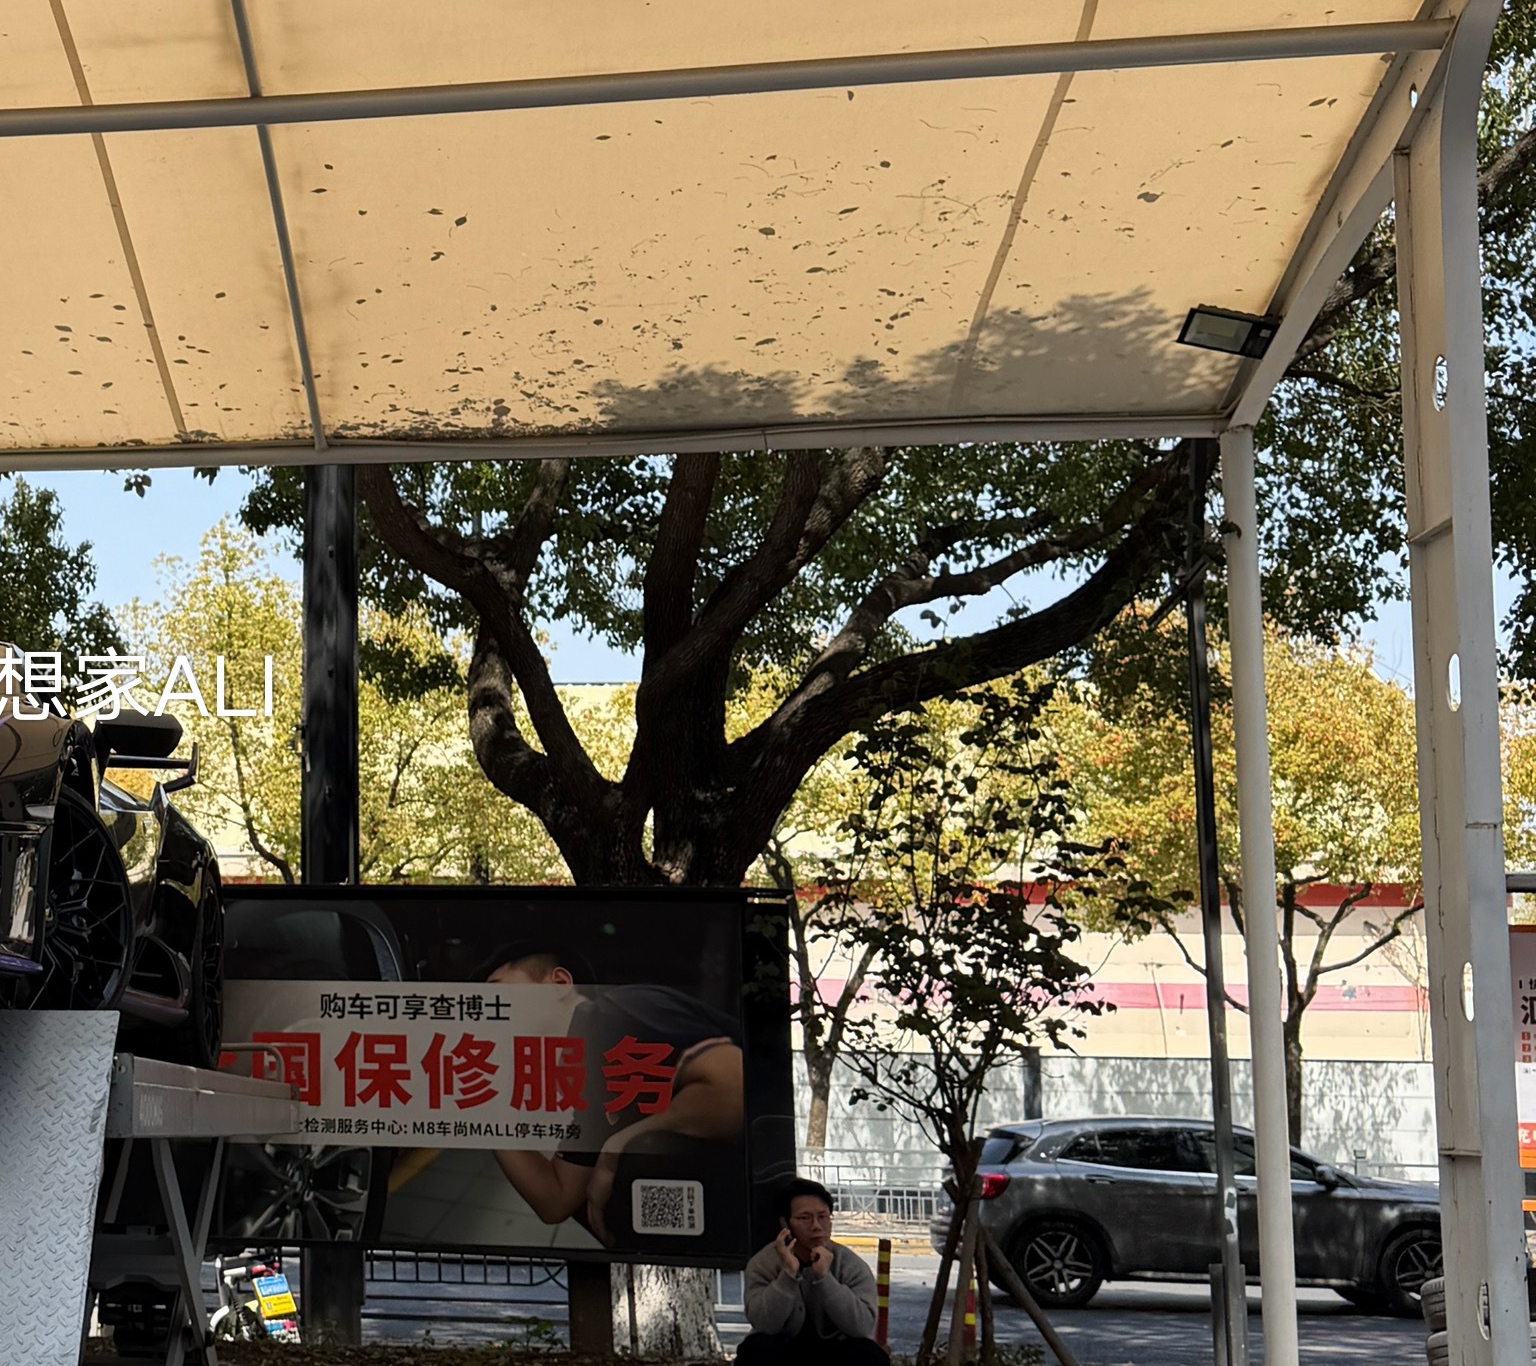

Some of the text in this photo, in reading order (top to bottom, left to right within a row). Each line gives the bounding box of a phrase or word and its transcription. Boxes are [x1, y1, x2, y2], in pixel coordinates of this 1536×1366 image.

[319, 992, 512, 1022] 购车可享查博士
